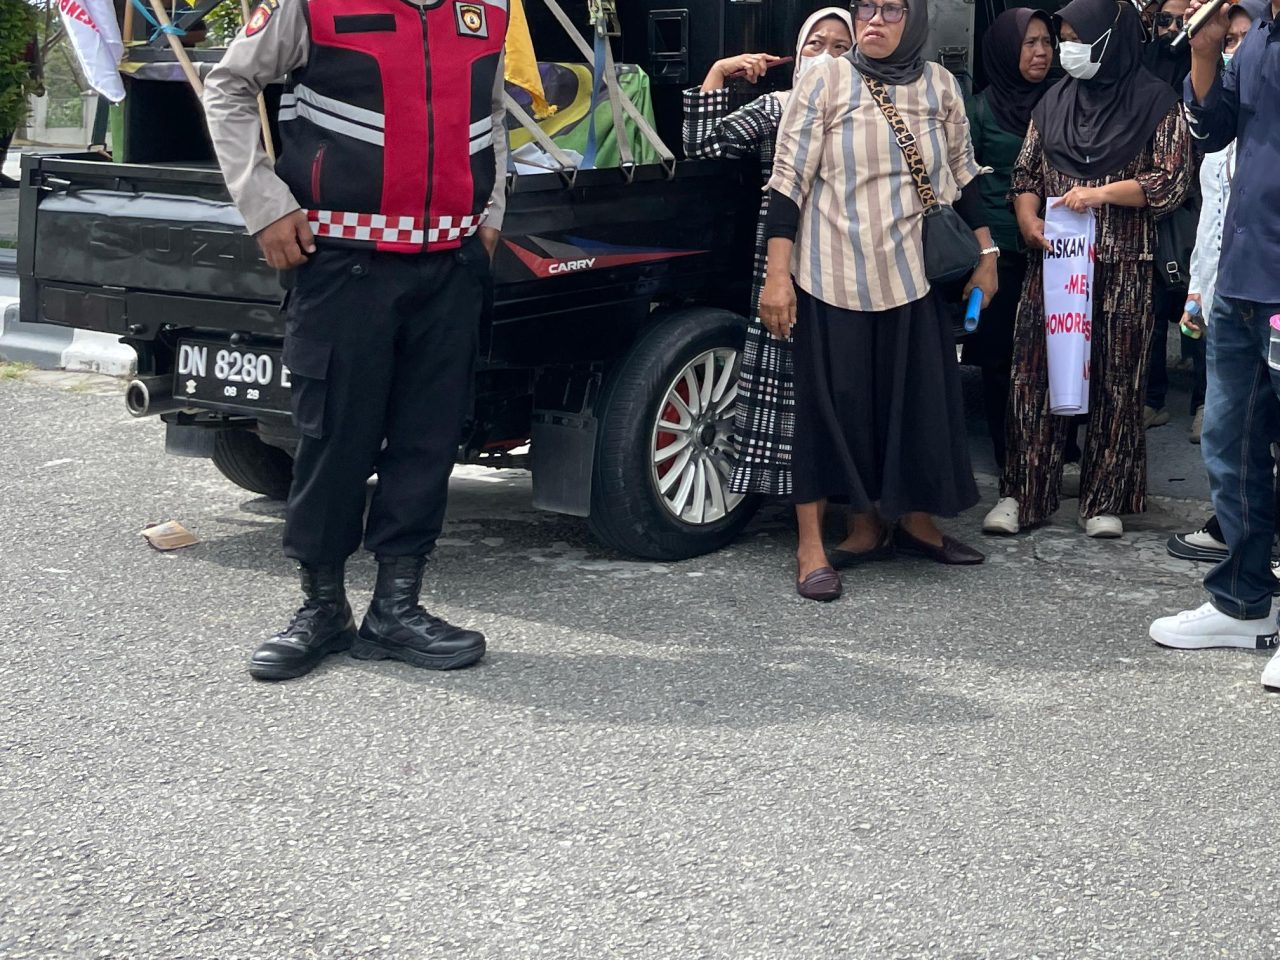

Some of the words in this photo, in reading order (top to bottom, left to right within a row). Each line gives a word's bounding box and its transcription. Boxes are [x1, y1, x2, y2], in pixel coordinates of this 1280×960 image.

[549, 257, 596, 274] CARRY
[178, 344, 208, 377] DN
[214, 349, 274, 386] 8280
